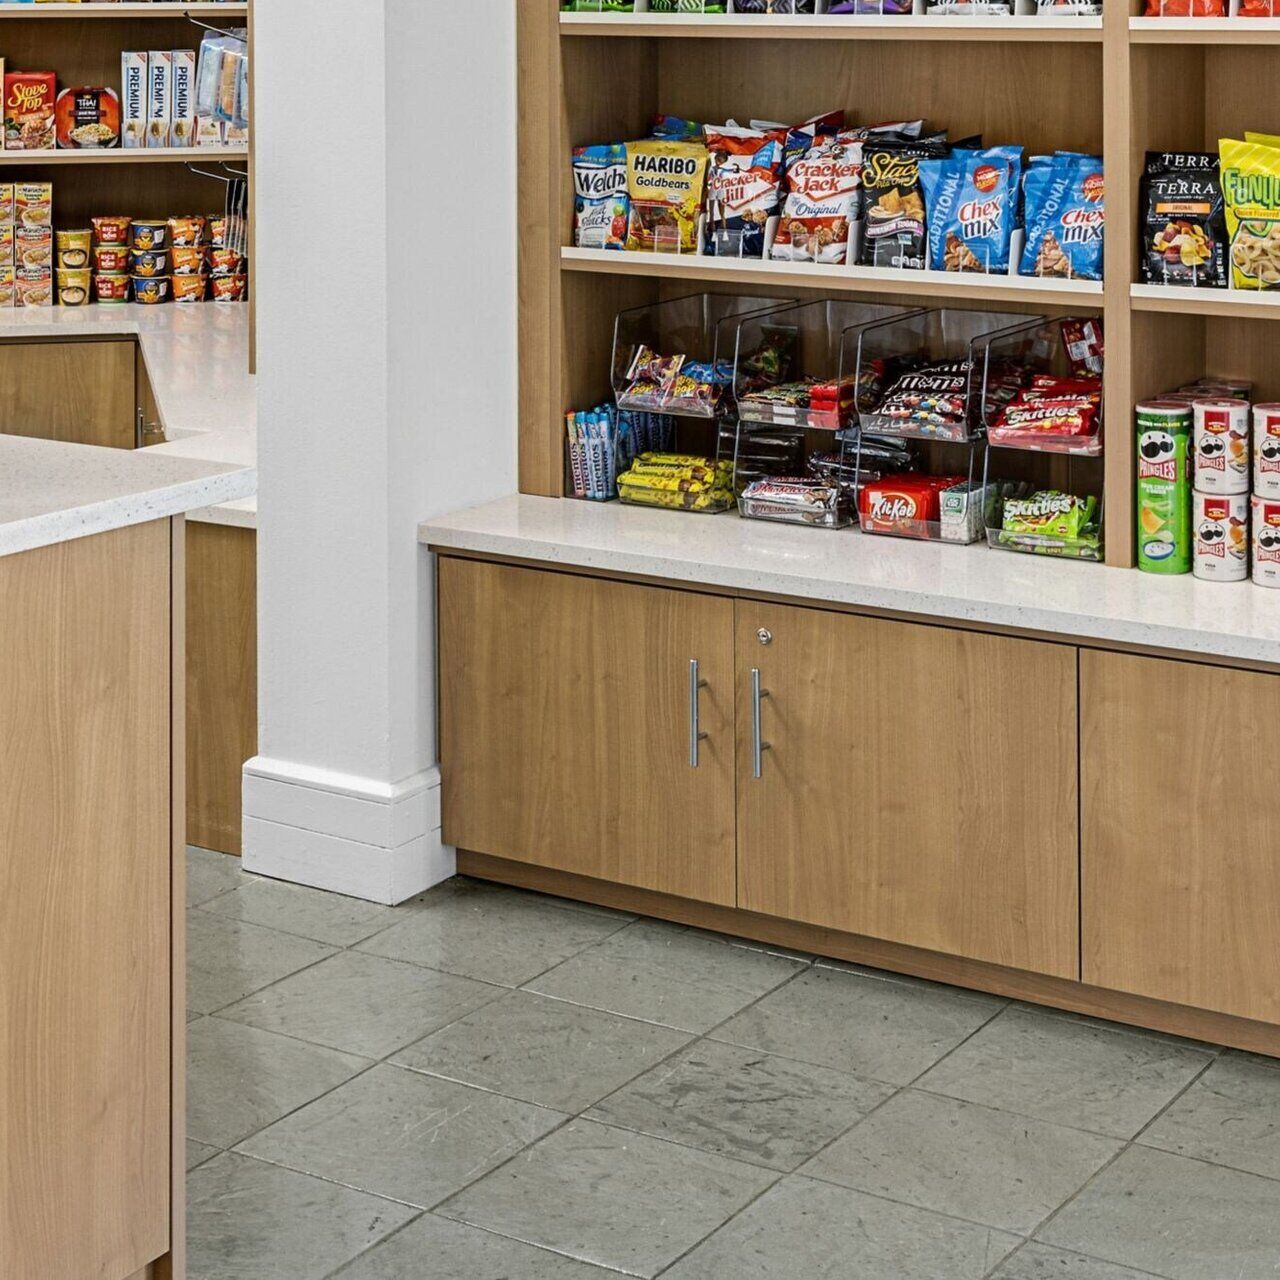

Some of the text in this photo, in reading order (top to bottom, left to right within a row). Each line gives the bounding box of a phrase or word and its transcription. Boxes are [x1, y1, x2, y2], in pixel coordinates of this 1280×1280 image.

[8, 83, 48, 107] Stove
[129, 66, 140, 119] PREMIUM
[177, 66, 188, 119] PREMIUM
[21, 97, 42, 112] Top
[76, 99, 97, 107] THAI
[634, 155, 696, 175] HARIBO
[1162, 153, 1220, 168] TERRA
[794, 163, 860, 178] Cracker
[636, 176, 690, 190] Goldbears
[711, 171, 761, 190] Cracker
[796, 177, 840, 194] Jack
[1157, 182, 1214, 194] TERRA
[722, 185, 745, 205] Jill
[960, 200, 1001, 222] Chex
[1062, 209, 1104, 225] Chex
[570, 441, 584, 491] mentos
[593, 442, 605, 493] mentos
[1139, 459, 1176, 482] PRINGLES
[1199, 455, 1225, 471] PRINGLES
[870, 496, 915, 519] KitKat
[1004, 496, 1072, 519] Skittles
[1198, 541, 1225, 558] PRINGLES
